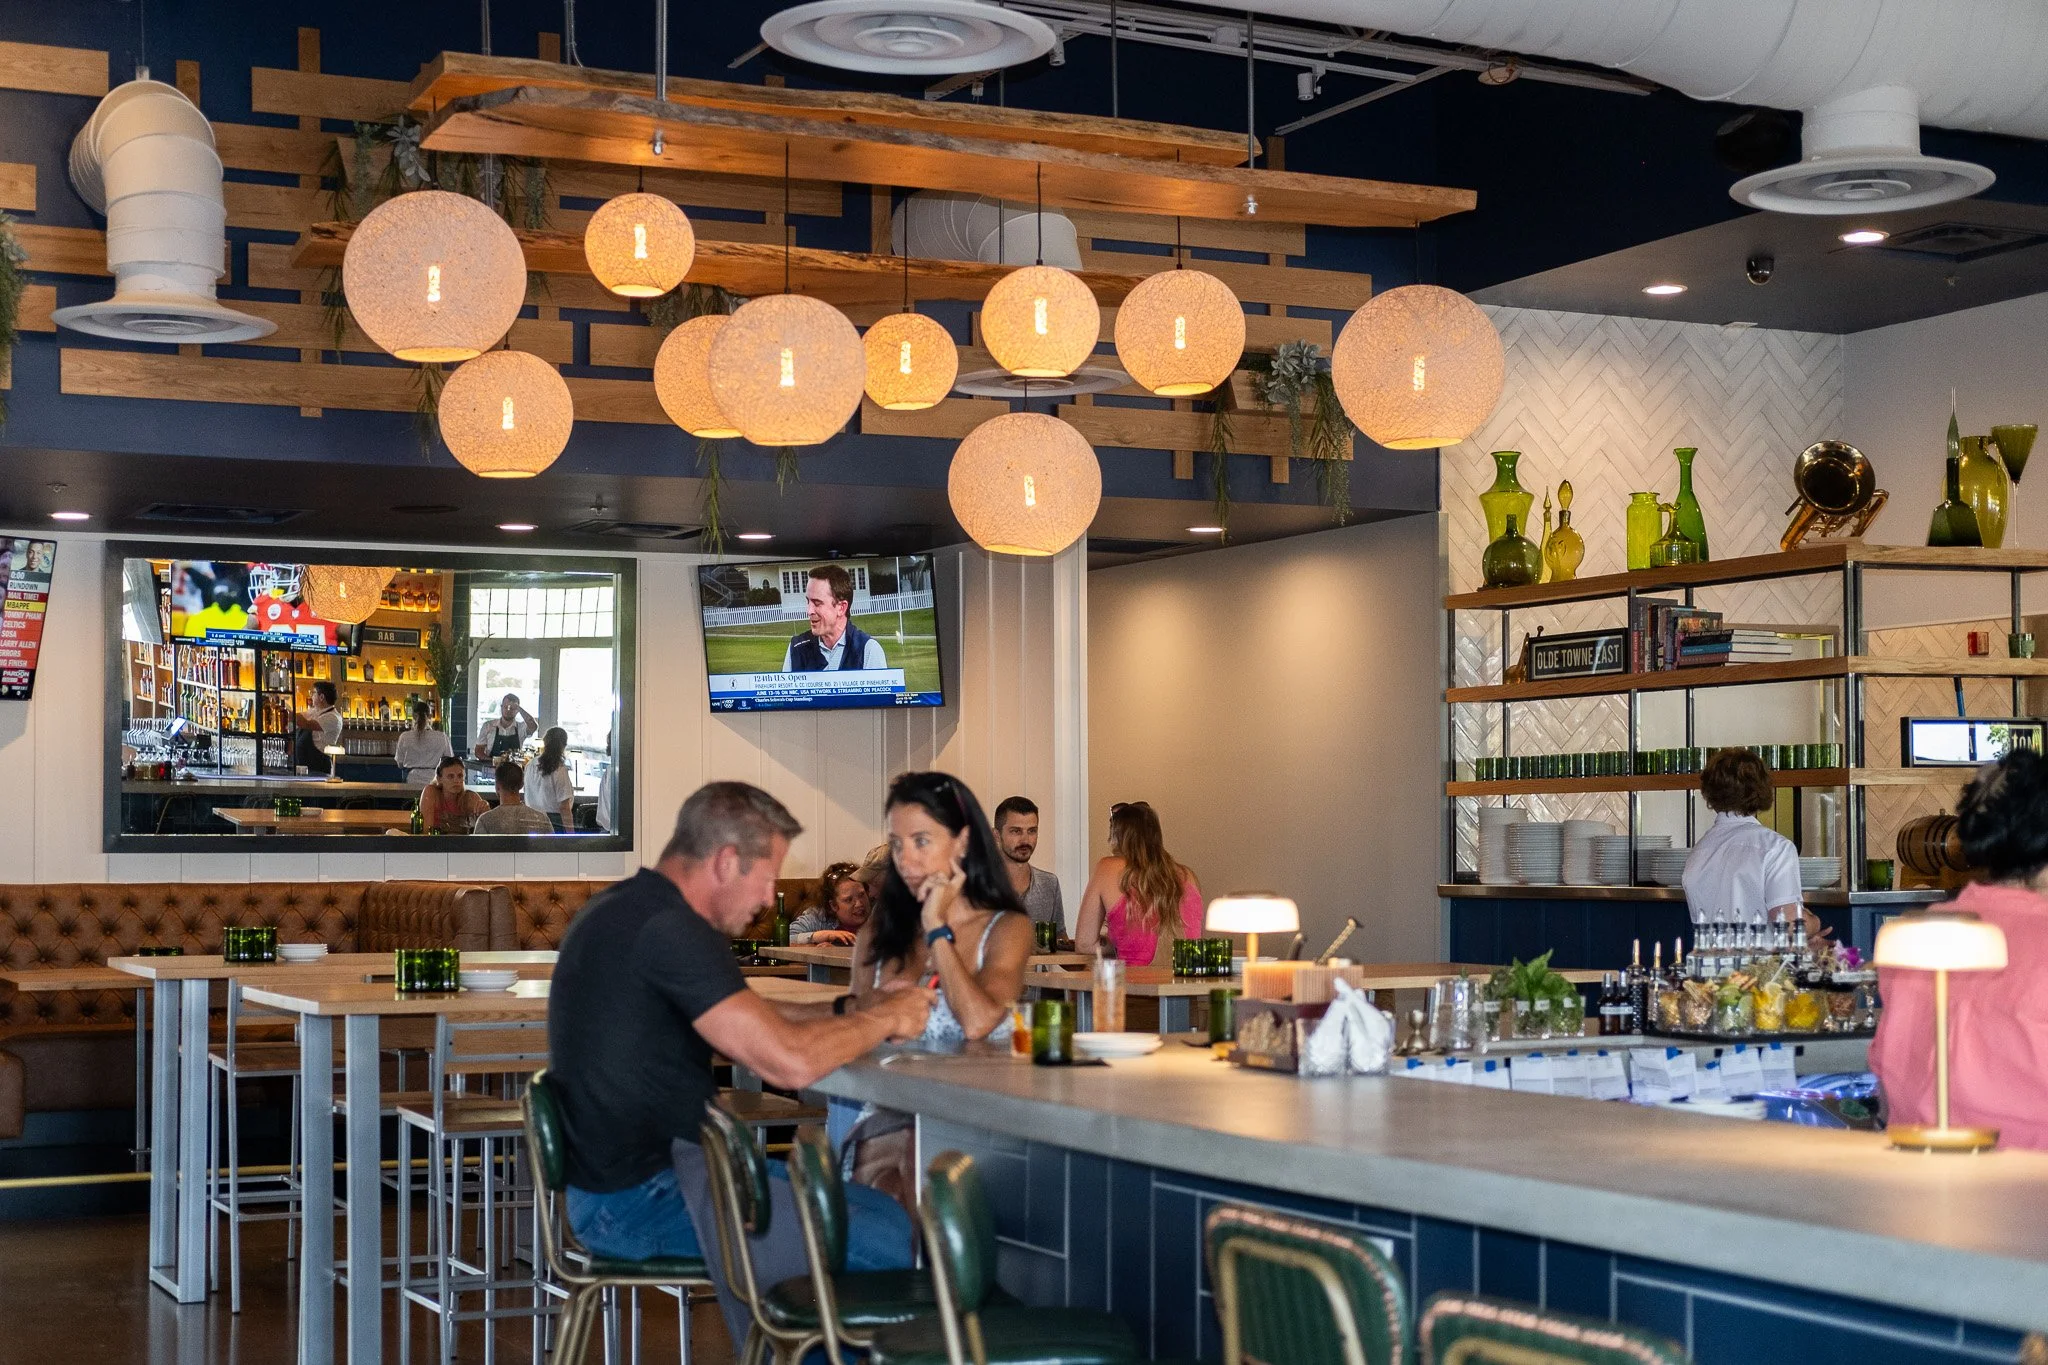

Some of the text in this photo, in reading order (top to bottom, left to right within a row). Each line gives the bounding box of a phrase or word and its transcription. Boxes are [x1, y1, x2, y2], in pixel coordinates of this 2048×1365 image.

[9, 581, 38, 590] RUNDOWN
[1, 630, 17, 638] SOSA
[1537, 651, 1559, 669] OLDE
[1561, 647, 1593, 667] TOWNE
[787, 674, 807, 683] Open
